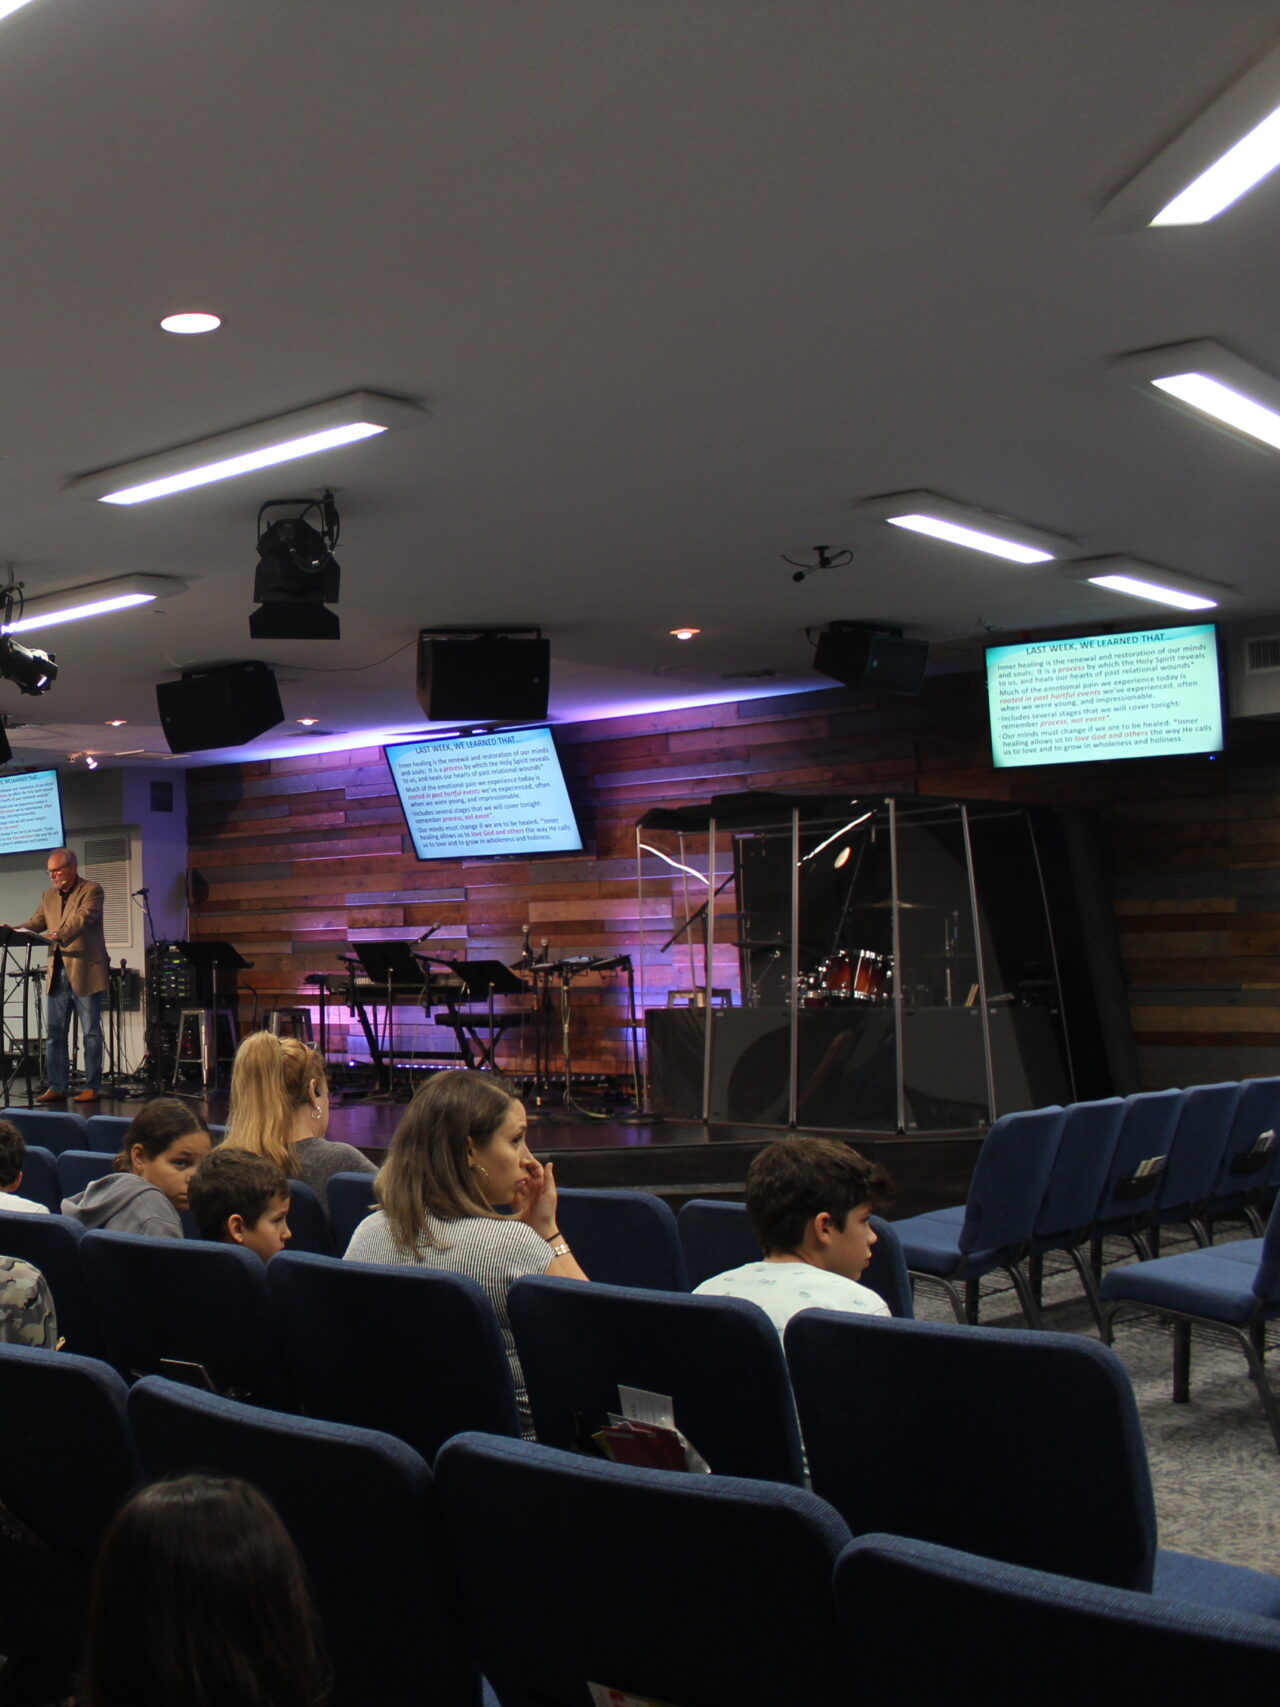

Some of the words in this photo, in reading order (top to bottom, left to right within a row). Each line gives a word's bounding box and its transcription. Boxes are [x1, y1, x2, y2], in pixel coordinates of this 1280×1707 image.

[1026, 645, 1046, 654] LAST
[1048, 642, 1076, 652] WEEK,
[1079, 640, 1096, 649] WE
[1097, 636, 1138, 647] LEARNED
[1017, 660, 1043, 669] healing
[1067, 654, 1096, 663] renewal
[1114, 649, 1155, 659] restoration
[1182, 643, 1206, 652] minds
[1057, 665, 1084, 673] process
[1097, 660, 1119, 668] which
[1136, 657, 1152, 665] Holy
[1155, 655, 1175, 663] Spirit
[1177, 652, 1205, 661] reveals
[1069, 671, 1092, 679] hearts
[1104, 669, 1119, 677] past
[1122, 665, 1157, 674] relational
[999, 688, 1018, 696] Much
[1043, 682, 1080, 692] emotional
[1113, 675, 1154, 686] experience
[1156, 673, 1178, 682] today
[1050, 691, 1075, 699] hurtful
[1176, 679, 1197, 687] often
[1000, 704, 1019, 712] when
[1000, 713, 1029, 721] Includes
[1032, 711, 1056, 719] several
[1058, 709, 1081, 717] stages
[1001, 721, 1038, 729] remember
[1016, 730, 1038, 738] minds
[1060, 726, 1086, 735] change
[1002, 739, 1028, 748] healing
[1030, 737, 1052, 745] allows
[1124, 729, 1148, 737] others
[1093, 739, 1131, 748] wholeness
[415, 746, 430, 754] LAST
[432, 743, 452, 752] WEEK,
[466, 738, 496, 748] LEARNED
[412, 759, 431, 767] healing
[447, 755, 469, 763] renewal
[481, 751, 511, 759] restoration
[471, 761, 487, 769] which
[513, 757, 527, 765] Spirit
[529, 755, 549, 763] reveals
[491, 766, 516, 775] relational
[437, 782, 463, 790] emotional
[487, 776, 516, 785] experience
